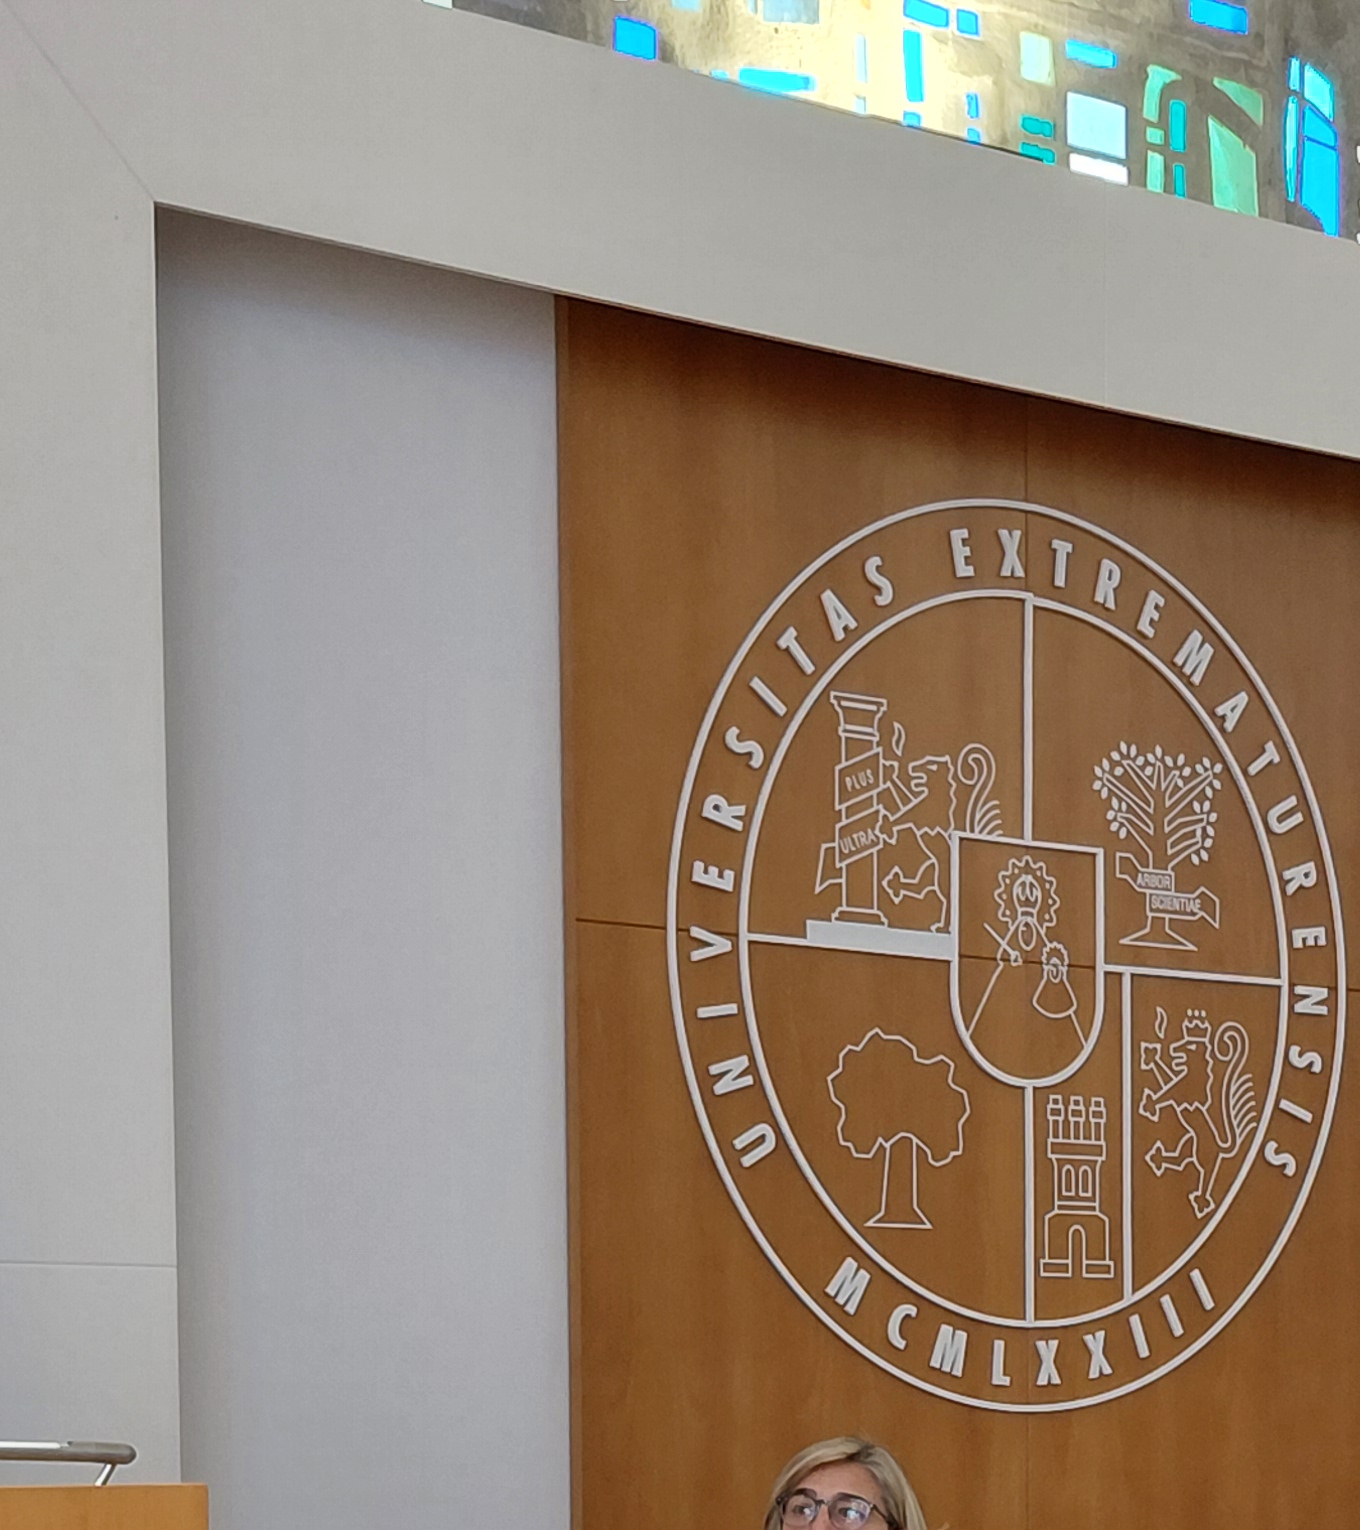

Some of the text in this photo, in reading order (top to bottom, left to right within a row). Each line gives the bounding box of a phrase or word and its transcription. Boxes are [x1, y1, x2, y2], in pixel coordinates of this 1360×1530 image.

[845, 768, 874, 792] PLUS
[690, 527, 1329, 1178] UNIVERSITAS EXTREMATURENSIS
[840, 828, 877, 854] ULTRA
[1137, 872, 1171, 890] ARBOR
[1151, 895, 1201, 913] SCIENTIAE
[827, 1256, 1216, 1386] MCMLXXIII
